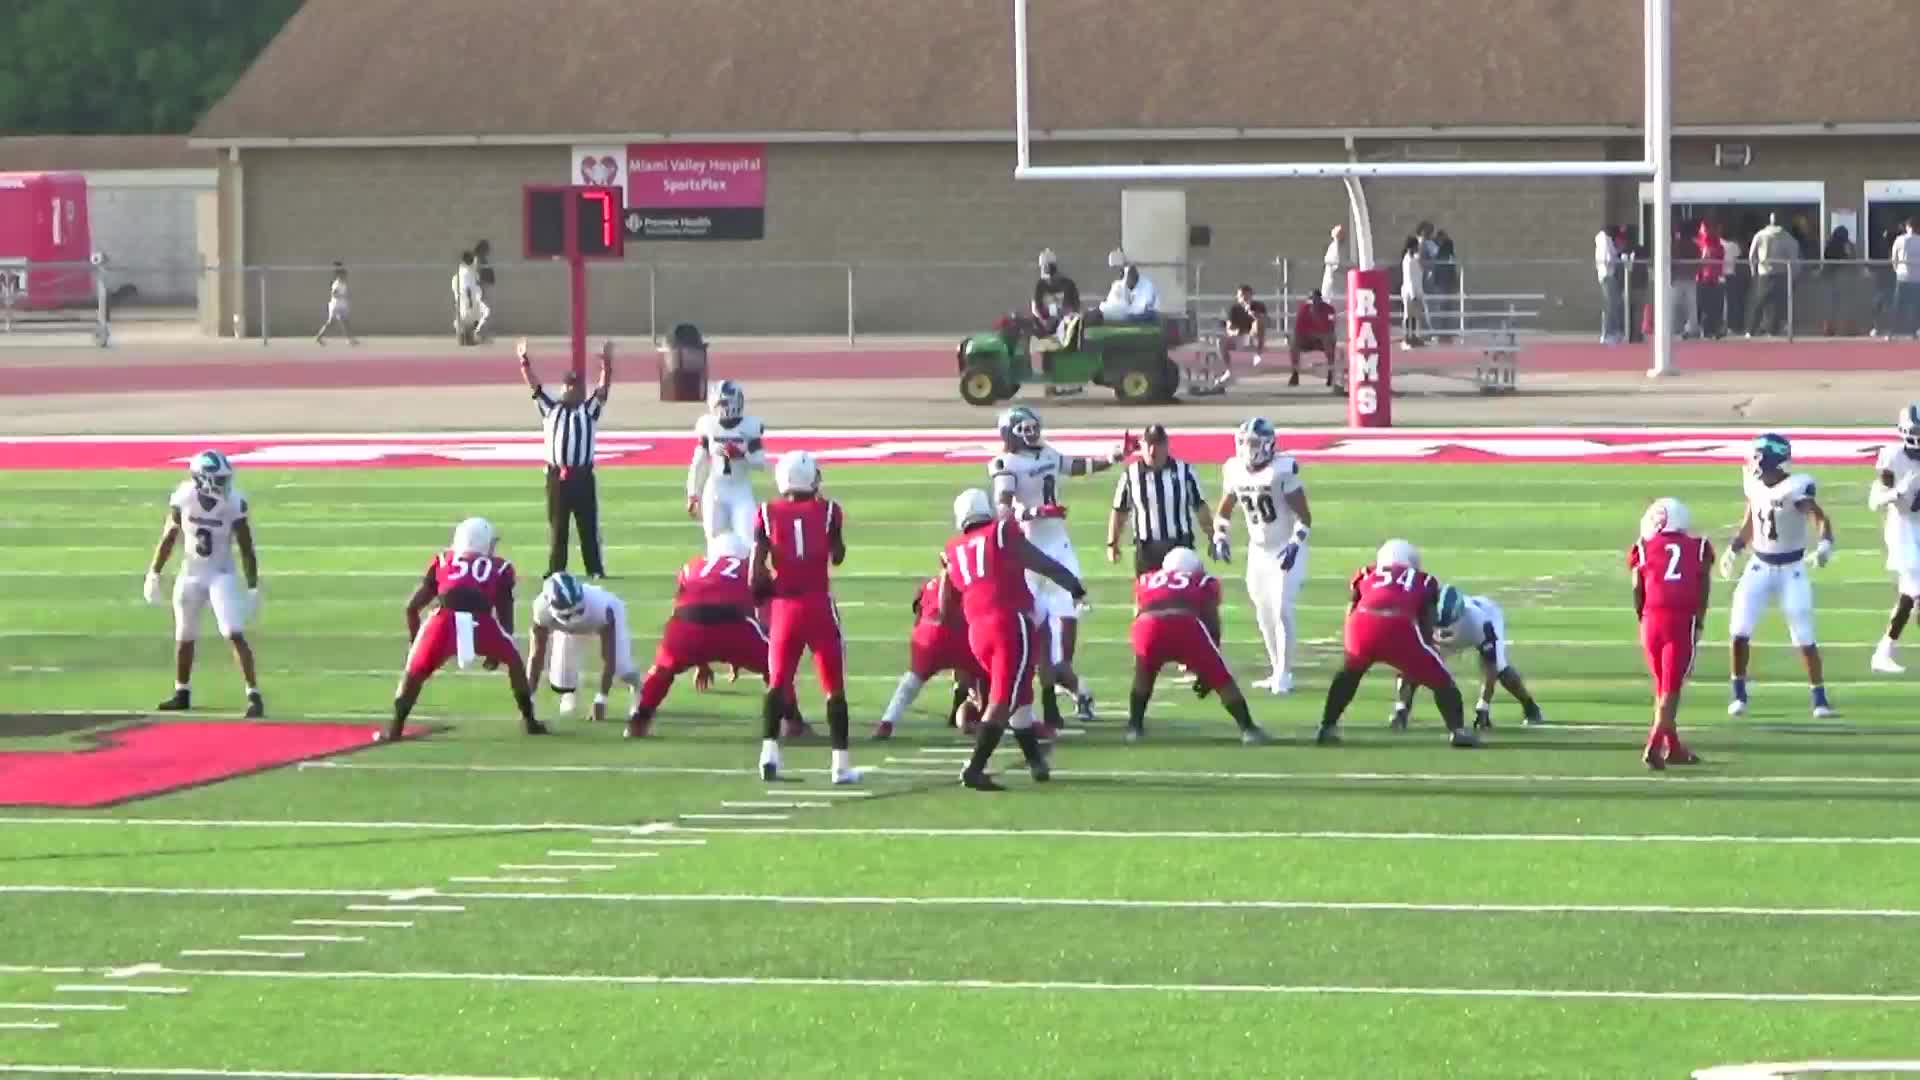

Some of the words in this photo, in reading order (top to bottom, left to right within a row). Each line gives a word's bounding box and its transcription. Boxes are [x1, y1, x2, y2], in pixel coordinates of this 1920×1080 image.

[629, 159, 668, 172] Miami
[670, 158, 706, 175] Valley
[709, 158, 761, 175] Hospital
[663, 178, 727, 196] SportsPlex
[581, 190, 612, 247] 7
[1355, 288, 1379, 415] RAMS
[195, 528, 212, 558] 3
[793, 518, 804, 560] 1
[448, 554, 493, 582] 50
[955, 536, 986, 586] 17
[1371, 564, 1416, 591] 54
[1663, 543, 1682, 581] 2
